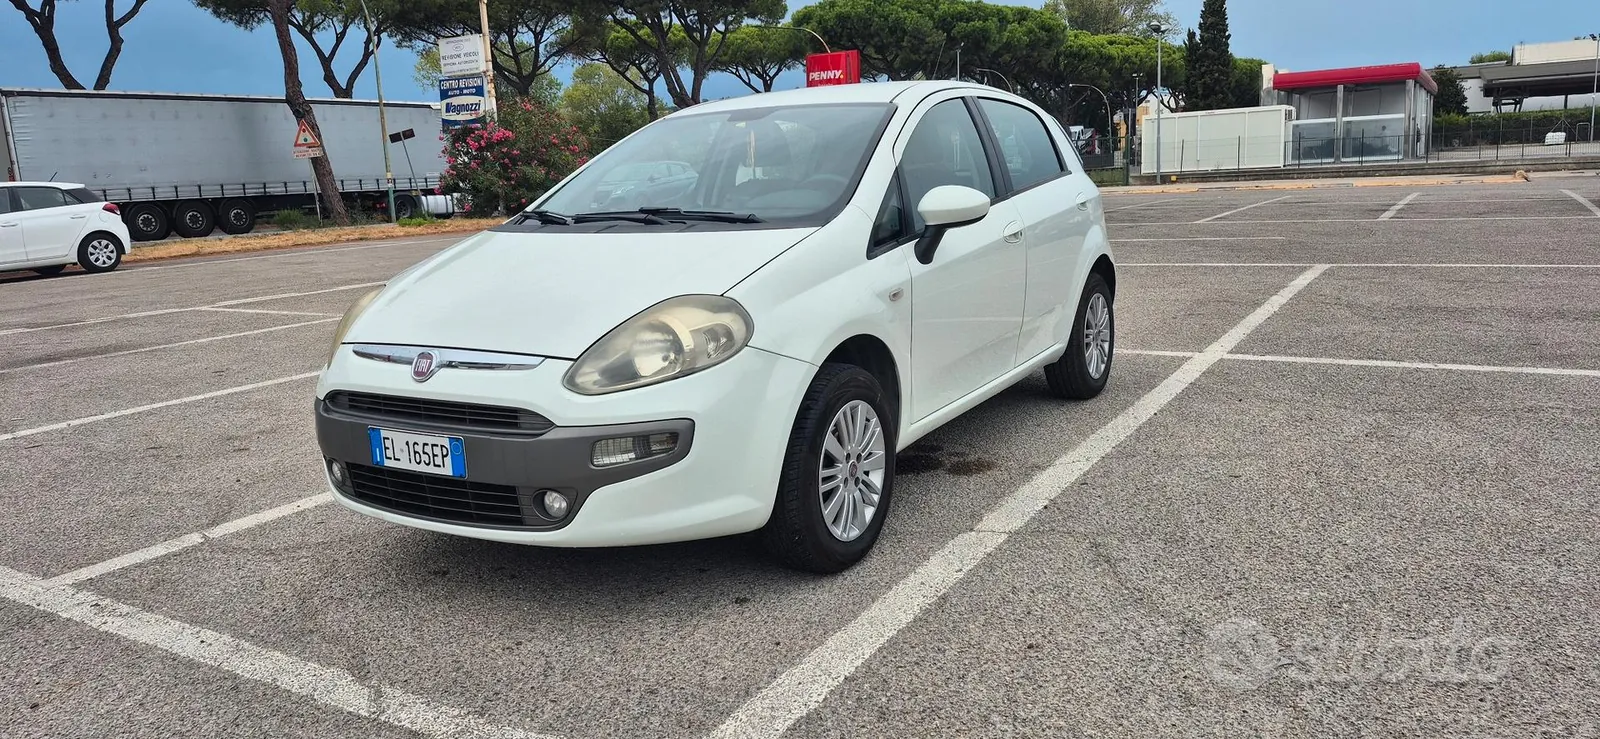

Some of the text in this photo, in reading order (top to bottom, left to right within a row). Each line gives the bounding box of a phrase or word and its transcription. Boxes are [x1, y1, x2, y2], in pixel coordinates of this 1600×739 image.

[440, 78, 482, 90] CENTRO REVISIONI
[415, 358, 431, 372] FIAT
[383, 437, 401, 462] EL
[405, 440, 450, 469] 165EP
